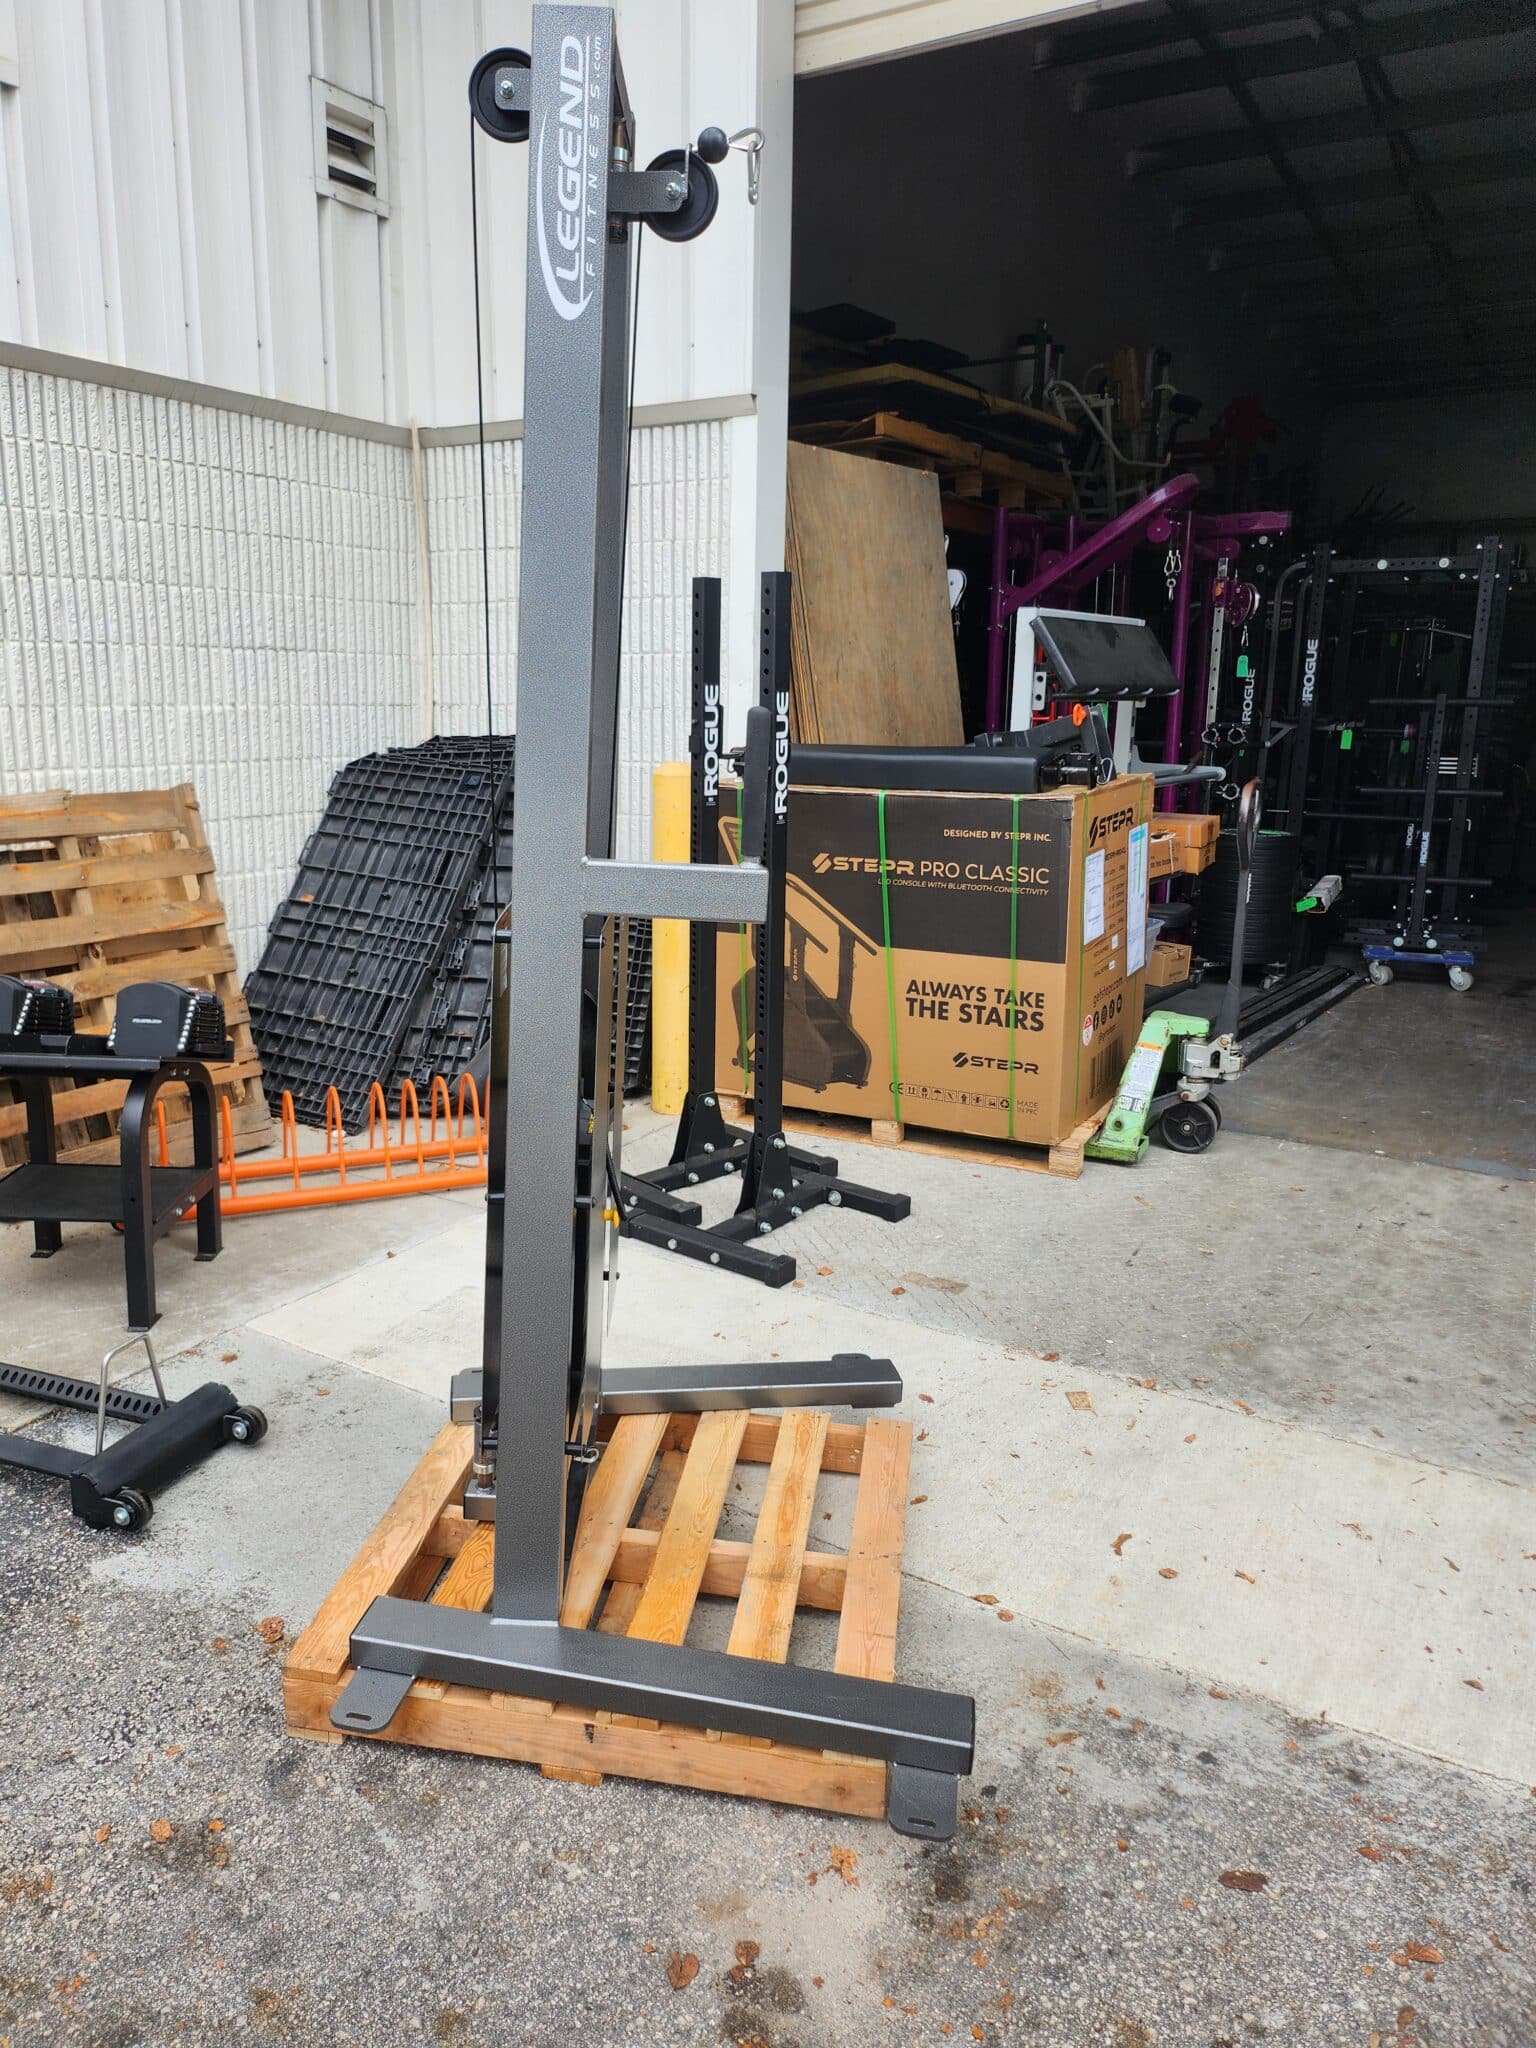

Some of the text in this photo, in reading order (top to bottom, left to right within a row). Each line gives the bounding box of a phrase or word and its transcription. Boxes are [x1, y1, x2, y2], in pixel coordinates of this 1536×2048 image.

[556, 35, 583, 281] LEGEND
[1303, 638, 1319, 701] ROGUE
[704, 684, 719, 797] ROGUE
[774, 691, 789, 815] ROGUE
[943, 828, 989, 839] DESIGNED
[990, 831, 1002, 840] BY
[1004, 831, 1032, 841] STEPR
[1098, 807, 1134, 839] STEPR
[1405, 823, 1415, 846] ROGU
[833, 856, 1050, 885] STEPR PRO CLASSIC
[877, 878, 892, 886] LD
[892, 879, 928, 888] CONSOLE
[927, 880, 947, 889] WITH
[947, 882, 993, 893] BLUETOOTH
[906, 979, 1045, 1009] ALWAYS TAKE
[905, 997, 1045, 1032] THE STAIRS
[970, 1055, 1040, 1075] STEPR
